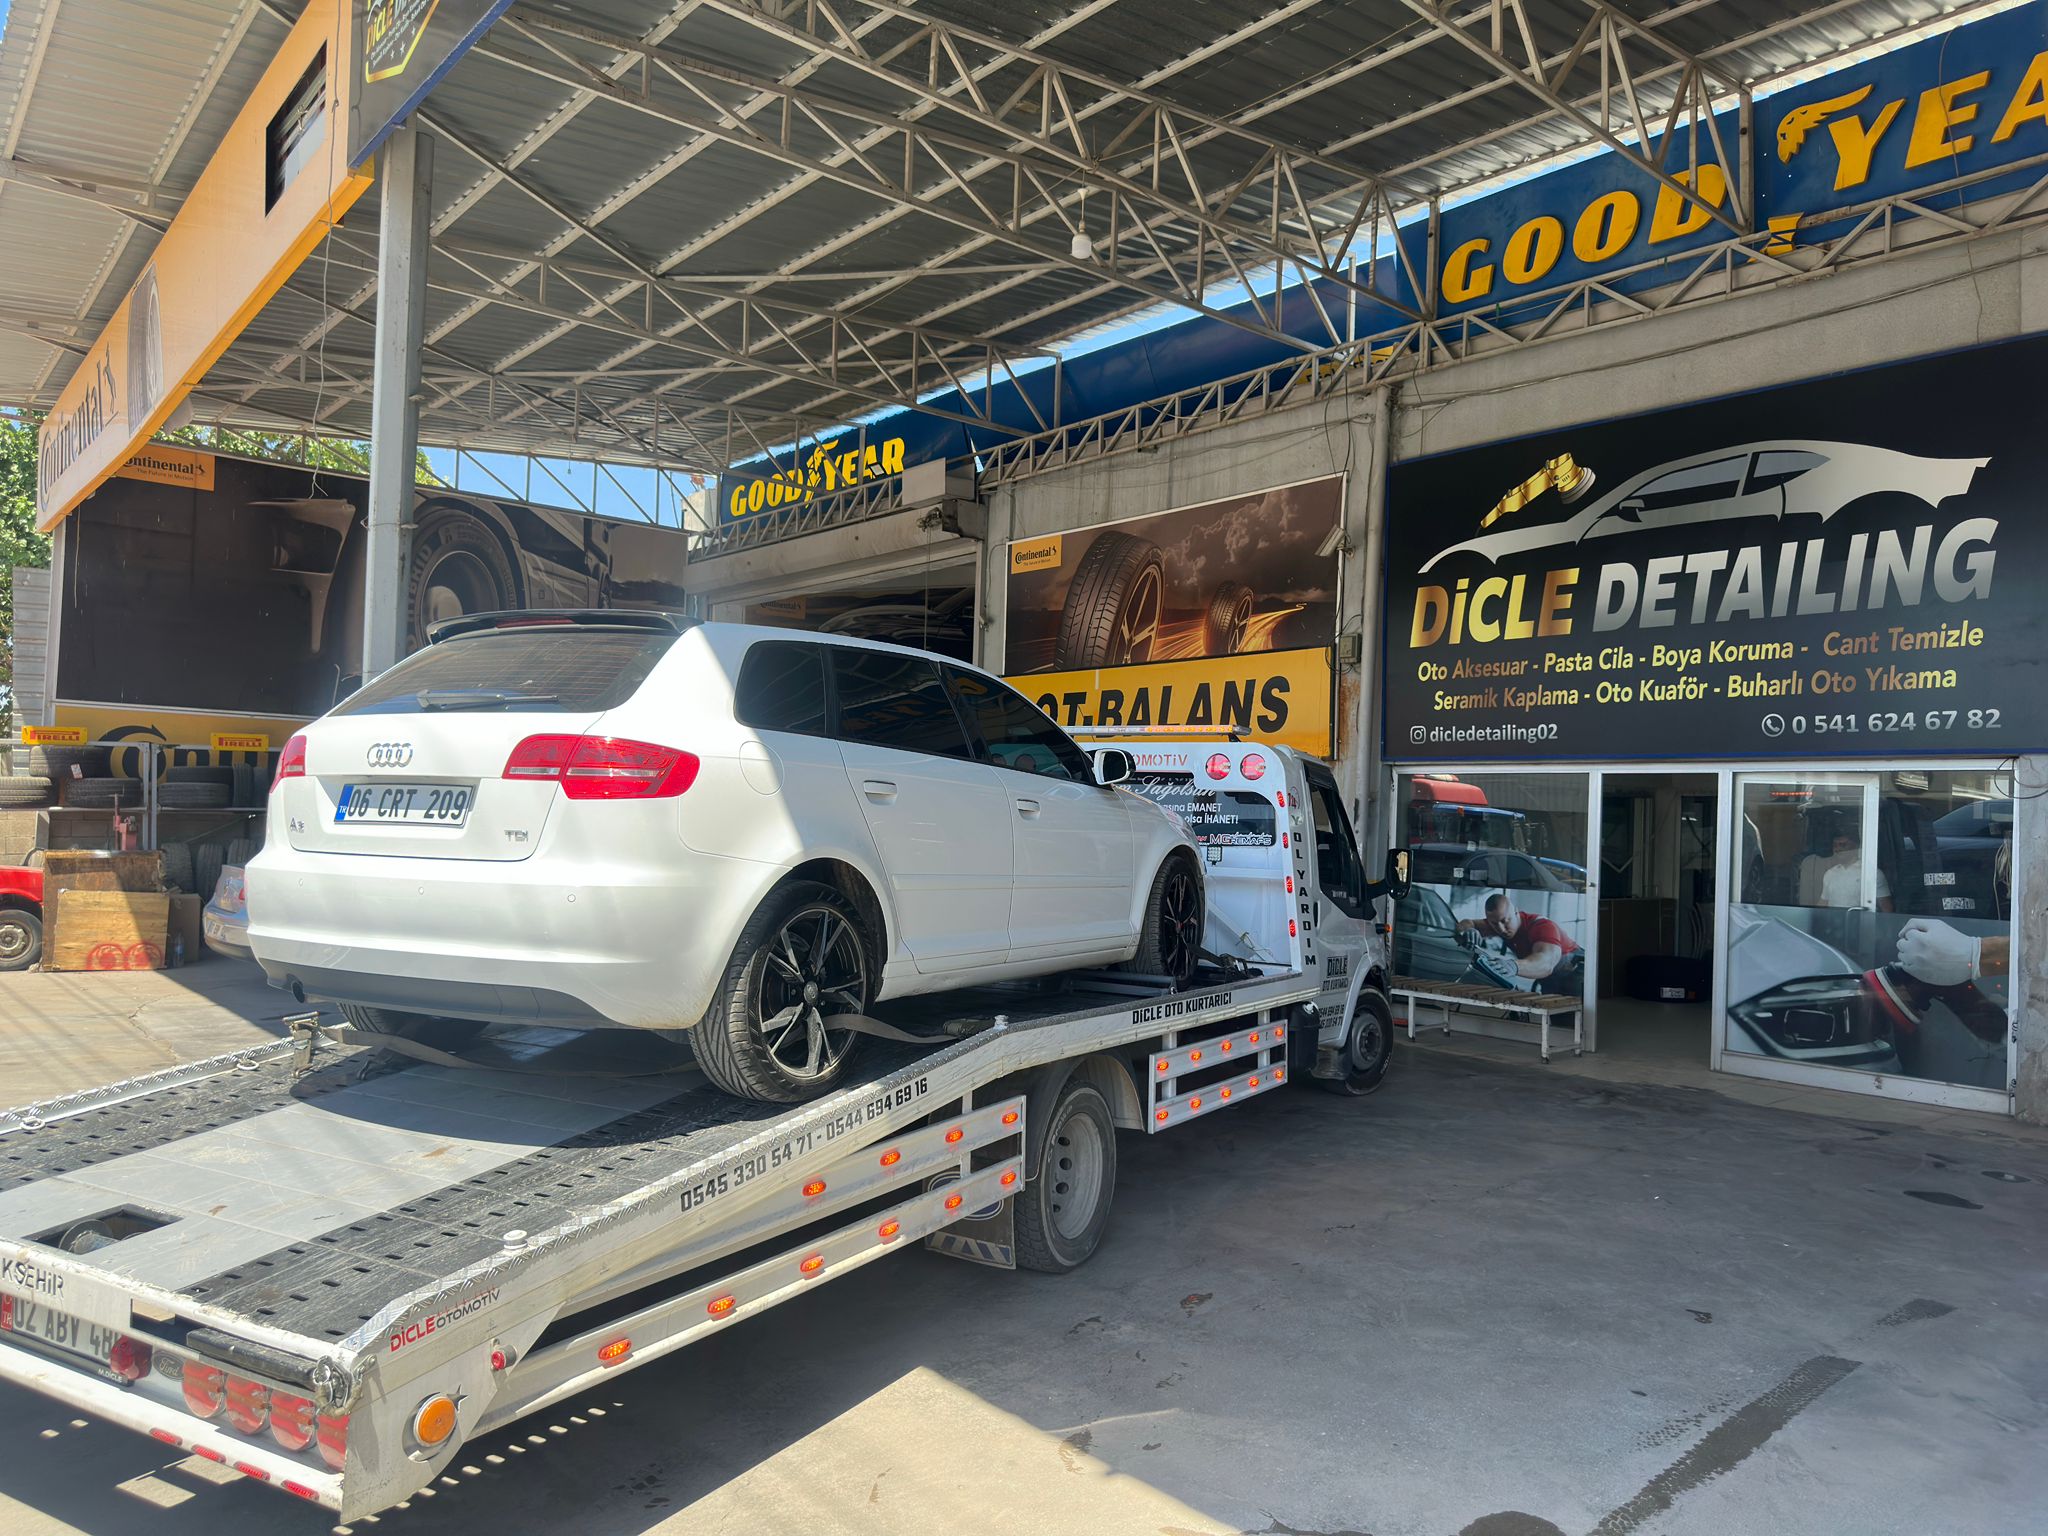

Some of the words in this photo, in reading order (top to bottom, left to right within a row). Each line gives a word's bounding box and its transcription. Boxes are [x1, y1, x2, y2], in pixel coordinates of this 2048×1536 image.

[40, 359, 104, 512] Continental
[123, 456, 194, 475] ontinental
[823, 437, 905, 491] YEAR
[1015, 547, 1052, 565] Continental
[1592, 517, 1999, 632] DETAILING
[1417, 662, 1448, 682] Oto
[1452, 658, 1528, 679] Aksesuar
[1544, 653, 1593, 674] Pasta
[1598, 646, 1634, 670] Cila
[1652, 645, 1701, 672] Boya
[1708, 640, 1794, 663] Koruma
[1823, 631, 1880, 657] Cant
[1888, 620, 1984, 652] Temizle
[1433, 687, 1498, 711] Seramik
[1503, 684, 1579, 712] Kaplama
[1595, 681, 1633, 703] Oto
[1639, 676, 1708, 702] Kuaför
[1727, 670, 1803, 698] Buharlı
[1810, 669, 1857, 695] Oto
[1865, 664, 1957, 692] Yıkama
[1430, 723, 1559, 744] dicledetailing02
[1792, 715, 1807, 734] 0
[1814, 713, 1860, 734] 541
[1868, 711, 1917, 732] 624
[1925, 709, 1958, 730] 67
[1966, 708, 2002, 729] 82
[30, 730, 81, 742] PIRELLI
[218, 737, 262, 748] PIRELLI
[339, 806, 347, 814] TR
[348, 788, 373, 817] 06
[378, 789, 417, 818] CRT
[424, 790, 468, 820] 209
[1187, 803, 1222, 812] EMANET
[1165, 1002, 1183, 1017] OTO
[1186, 992, 1232, 1013] KURTARICI
[680, 1173, 728, 1212] 0545
[734, 1154, 767, 1187] 330
[772, 1143, 793, 1168] 54
[798, 1132, 813, 1155] 71
[826, 1109, 864, 1141] 0544
[866, 1094, 893, 1121] 694
[895, 1085, 912, 1106] 69
[916, 1077, 928, 1097] 16
[3, 1311, 12, 1325] TR
[89, 1323, 119, 1360] 48
[159, 1358, 179, 1377] Ford
